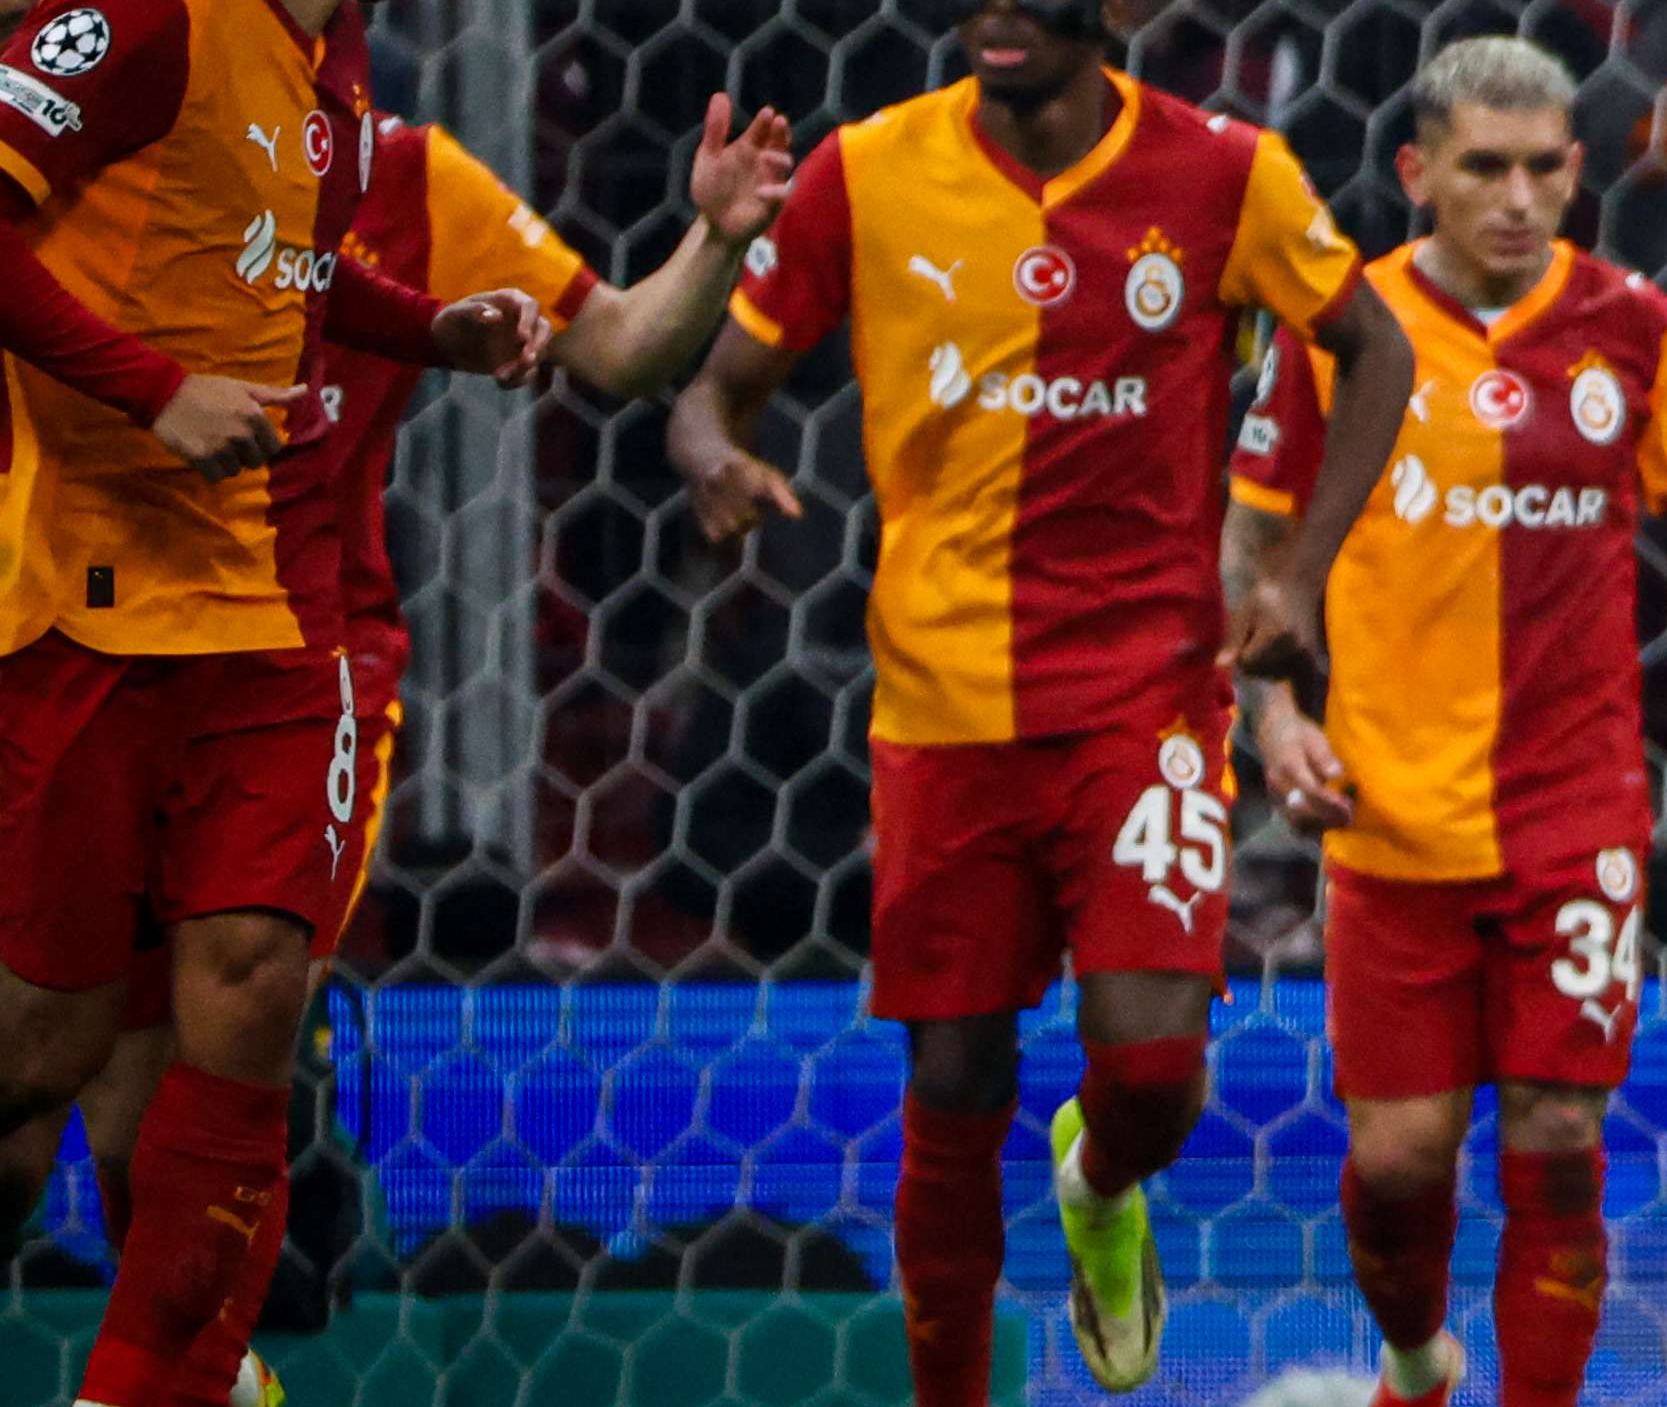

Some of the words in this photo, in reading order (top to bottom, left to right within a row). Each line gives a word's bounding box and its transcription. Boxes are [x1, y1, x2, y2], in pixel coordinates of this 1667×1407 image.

[977, 371, 1147, 419] SOCAR
[1443, 483, 1606, 529] SOCAR
[1112, 784, 1228, 892] 45
[1551, 899, 1642, 1001] 34
